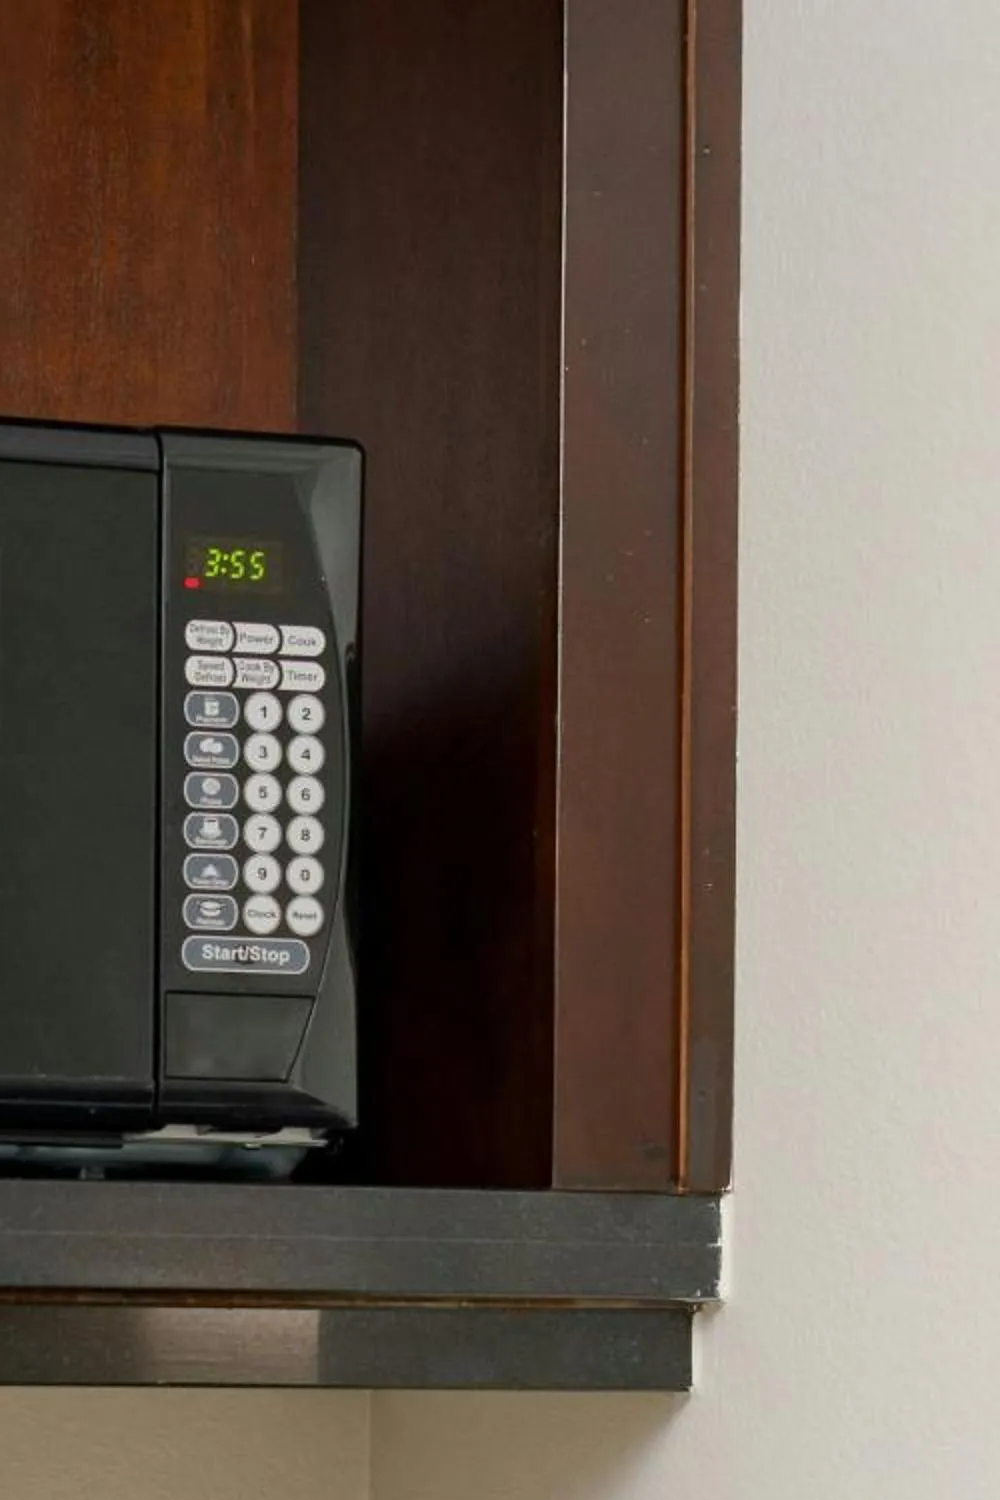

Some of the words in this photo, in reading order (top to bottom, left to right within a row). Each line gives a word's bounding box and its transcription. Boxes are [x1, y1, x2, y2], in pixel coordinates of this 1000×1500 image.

[205, 549, 265, 580] 3:55
[239, 631, 274, 645] Power
[260, 706, 268, 719] 1
[301, 708, 312, 721] 2
[258, 746, 268, 760] 3
[300, 749, 311, 761] 4
[258, 786, 268, 799] 5
[301, 788, 311, 801] 6
[257, 827, 268, 840] 7
[300, 829, 311, 842] 8
[257, 867, 267, 881] 9
[300, 869, 311, 882] 0
[202, 943, 291, 966] Start/Stop
